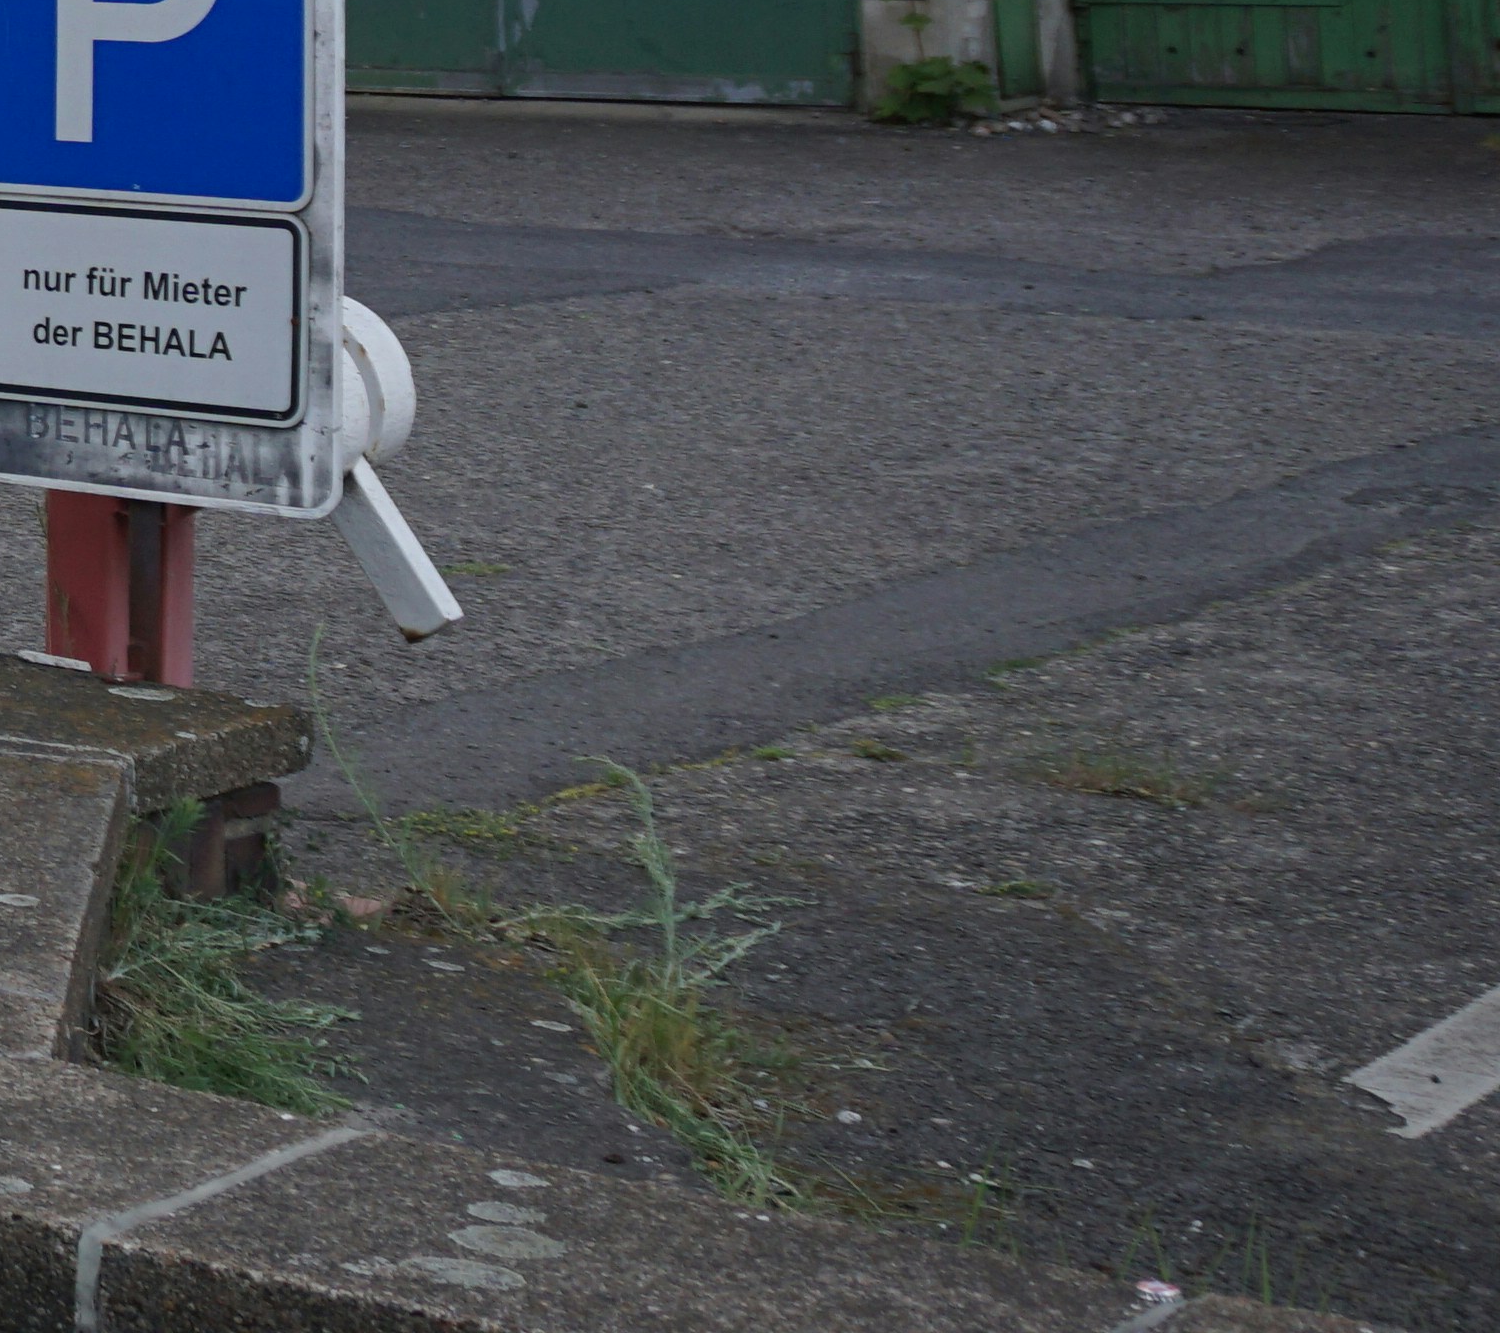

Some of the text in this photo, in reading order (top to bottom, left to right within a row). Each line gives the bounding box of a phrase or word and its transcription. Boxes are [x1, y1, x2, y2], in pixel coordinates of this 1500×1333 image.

[22, 266, 248, 307] nur für Mieter
[33, 316, 233, 361] der BEHALA
[25, 404, 190, 456] BEHALA
